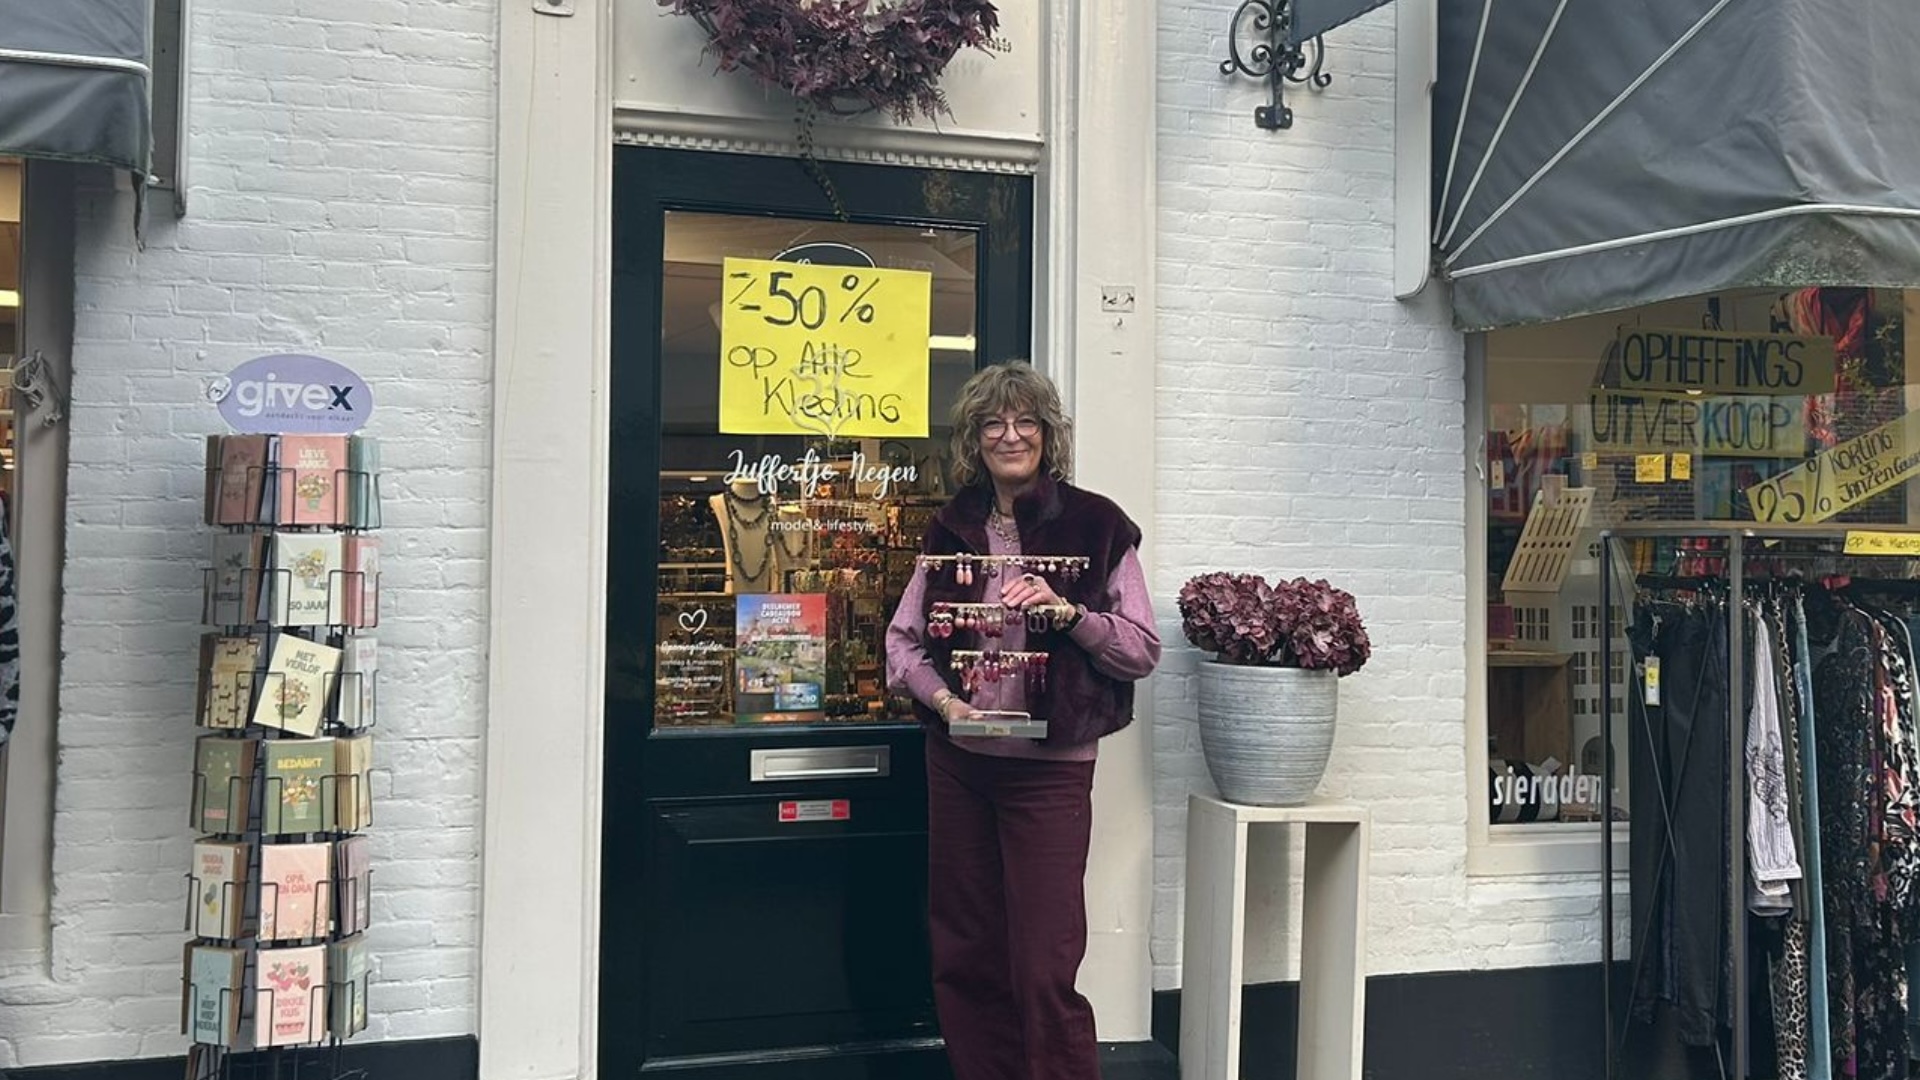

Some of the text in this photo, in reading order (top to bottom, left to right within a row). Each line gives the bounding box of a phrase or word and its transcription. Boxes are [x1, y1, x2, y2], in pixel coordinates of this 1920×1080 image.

[728, 345, 777, 380] op
[236, 372, 353, 416] givex
[849, 450, 918, 500] Negen
[771, 519, 811, 532] mode
[813, 520, 822, 532] &
[1493, 764, 1602, 806] sieraden
